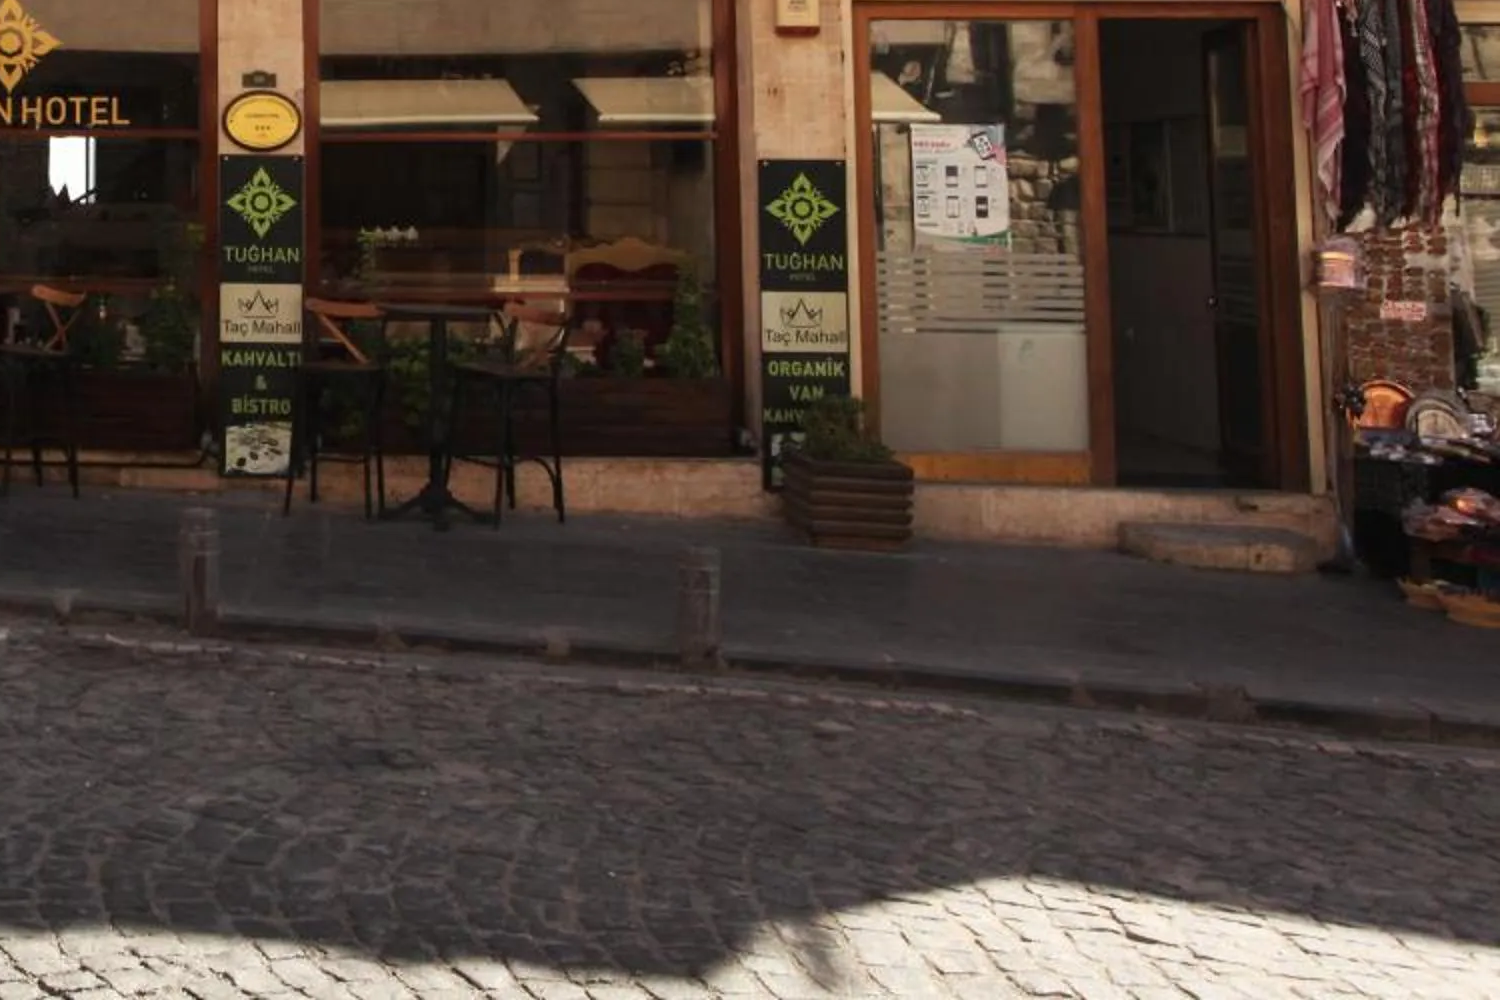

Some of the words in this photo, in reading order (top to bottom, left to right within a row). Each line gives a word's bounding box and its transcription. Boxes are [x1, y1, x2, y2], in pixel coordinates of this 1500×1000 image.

[22, 97, 130, 126] HOTEL
[768, 357, 845, 376] ORGANİK
[789, 384, 824, 400] VAN
[231, 394, 291, 415] BİSTRO
[763, 407, 805, 424] KAHV
